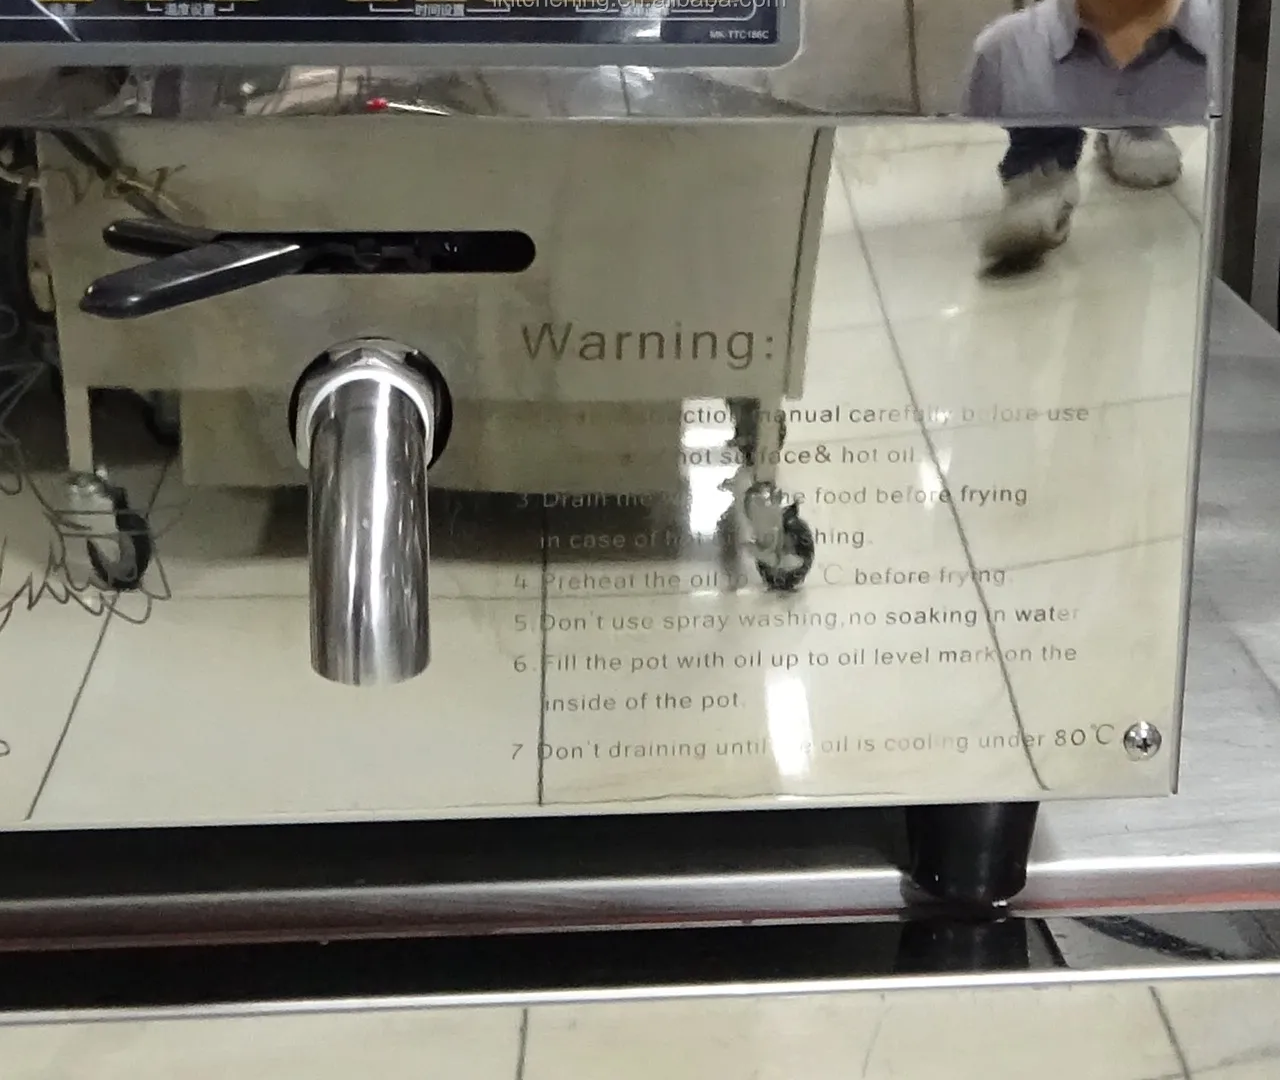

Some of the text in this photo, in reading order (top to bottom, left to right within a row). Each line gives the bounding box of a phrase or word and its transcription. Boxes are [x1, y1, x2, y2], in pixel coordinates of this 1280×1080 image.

[522, 321, 773, 370] Warning:
[1046, 407, 1090, 422] use
[841, 446, 878, 464] hot
[815, 486, 867, 504] food
[960, 485, 1028, 507] frying
[569, 535, 625, 550] case
[634, 529, 658, 548] of
[645, 570, 681, 589] the
[689, 568, 718, 587] oil
[854, 568, 930, 586] before
[541, 610, 603, 631] Don't
[663, 614, 728, 633] spray
[884, 606, 978, 628] soaking
[1014, 605, 1081, 623] water
[585, 652, 622, 671] the
[631, 654, 669, 674] pot
[676, 650, 725, 669] with
[734, 650, 762, 668] oil
[770, 652, 799, 670] up
[808, 650, 830, 666] to
[837, 648, 866, 666] oil
[873, 647, 930, 665] level
[937, 646, 995, 664] mark
[1004, 648, 1032, 662] on
[1040, 644, 1078, 662] the
[543, 693, 617, 712] inside
[625, 692, 648, 710] of
[655, 692, 693, 710] the
[510, 743, 524, 761] 7
[539, 739, 600, 761] Don't
[608, 739, 707, 761] draining
[820, 735, 848, 753] oil
[856, 735, 876, 752] is
[978, 731, 1046, 750] under
